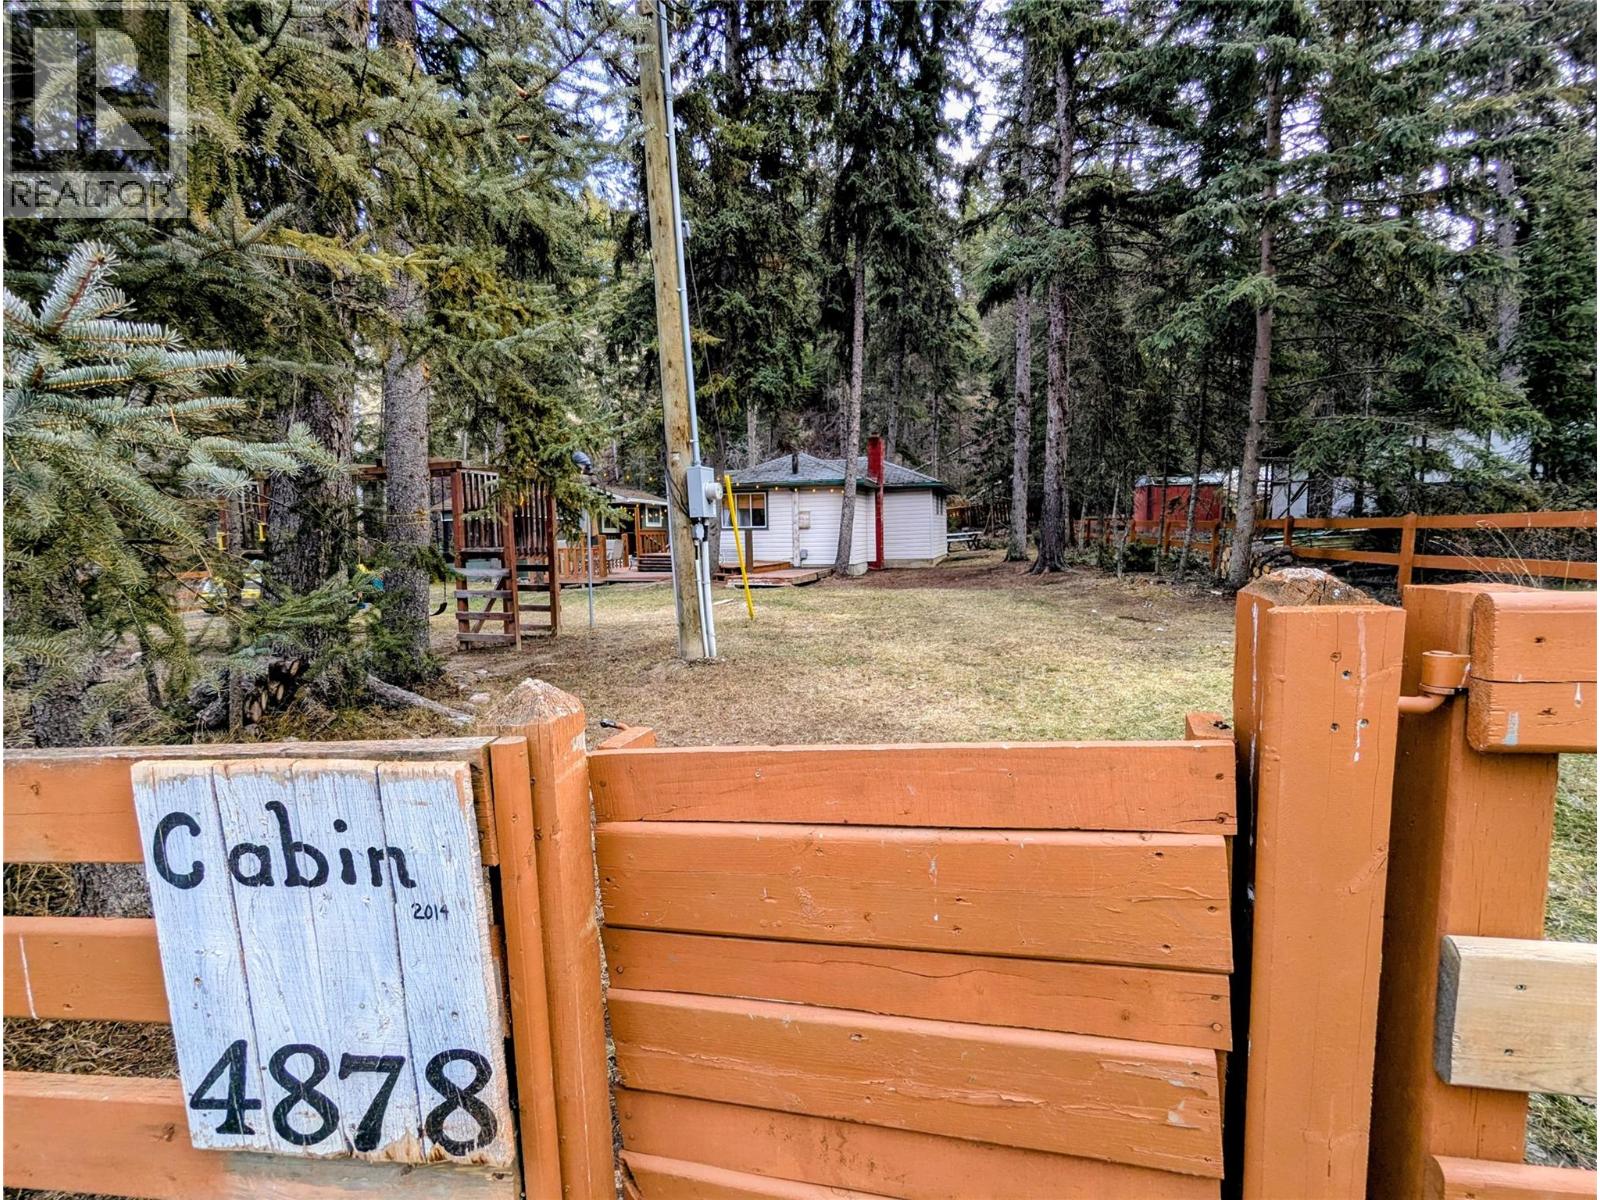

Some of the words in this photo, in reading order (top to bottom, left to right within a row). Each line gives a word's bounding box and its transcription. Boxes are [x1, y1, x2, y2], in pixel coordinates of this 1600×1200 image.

[152, 800, 417, 890] Cabin
[411, 902, 449, 921] 2014
[189, 1039, 498, 1157] 4878
